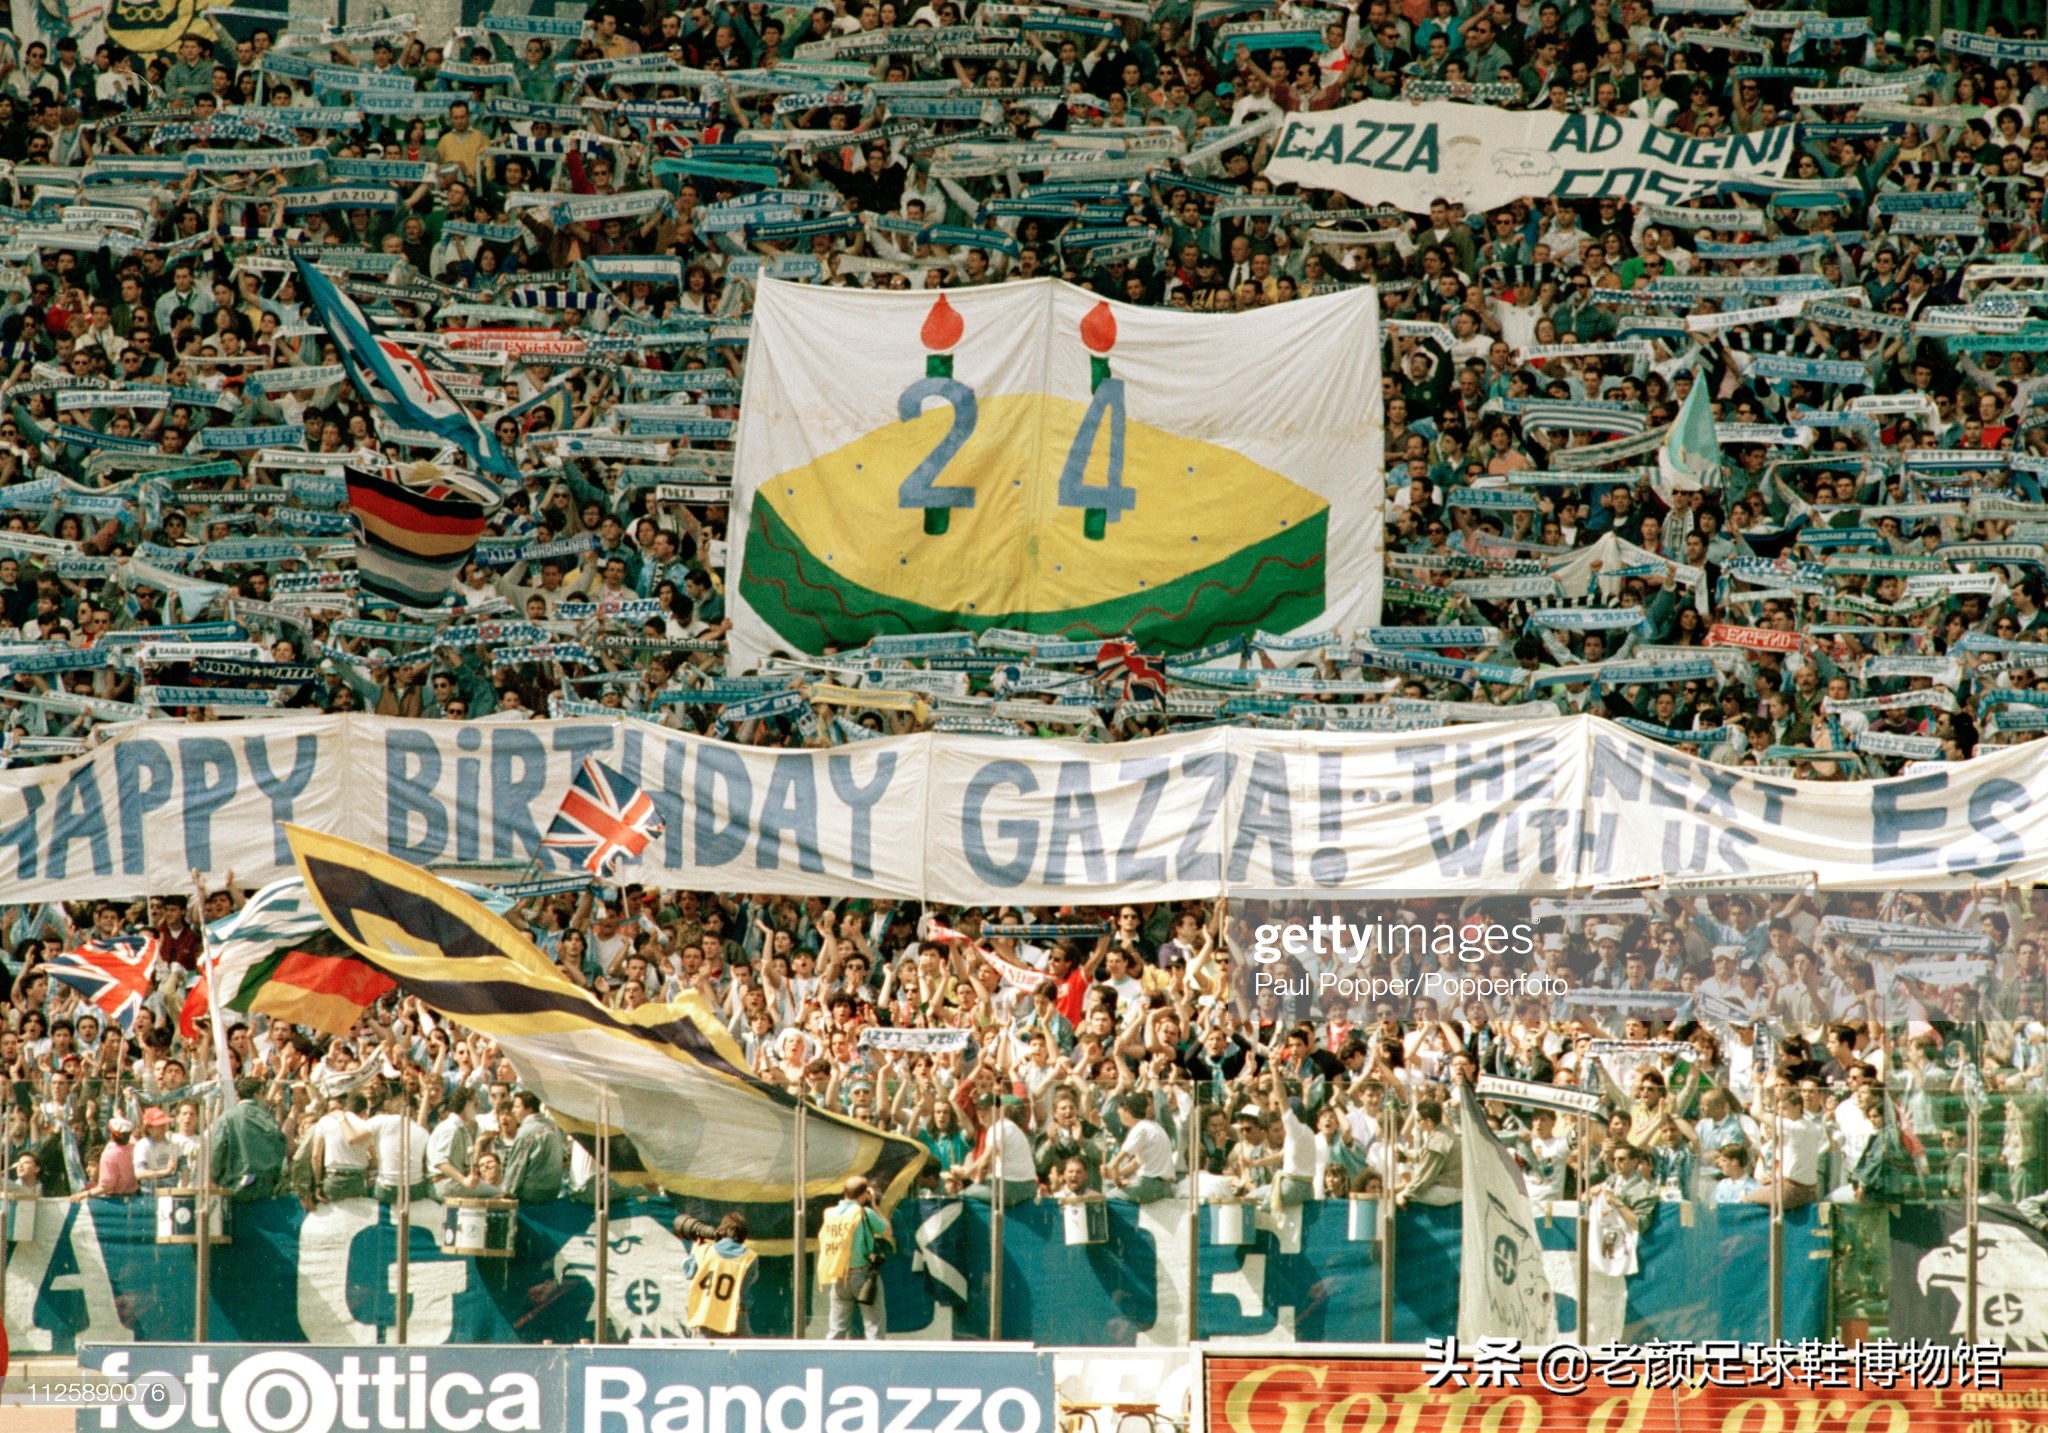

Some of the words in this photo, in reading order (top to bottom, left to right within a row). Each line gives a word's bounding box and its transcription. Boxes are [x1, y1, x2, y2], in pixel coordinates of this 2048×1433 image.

[1275, 120, 1440, 174] GAZZA
[1549, 112, 1624, 153] AD
[1640, 122, 1796, 169] OGNI
[332, 190, 376, 201] LAZIO
[1814, 305, 1853, 319] FORZA
[504, 342, 574, 354] ENGLAND
[253, 493, 286, 502] LAZIO
[522, 538, 591, 560] BIRMINGHAM
[62, 562, 106, 572] FORZA
[273, 576, 319, 589] FORZA
[205, 660, 241, 676] FORZA
[1373, 652, 1456, 677] ENGLAND
[1588, 735, 1797, 825] NEXT
[1426, 809, 1617, 877] WITH
[1662, 819, 1759, 874] US
[699, 1269, 736, 1301] 40
[583, 1366, 1042, 1433] Randazzo
[1224, 1363, 1556, 1433] Gotto
[1959, 1387, 2048, 1413] grandi
